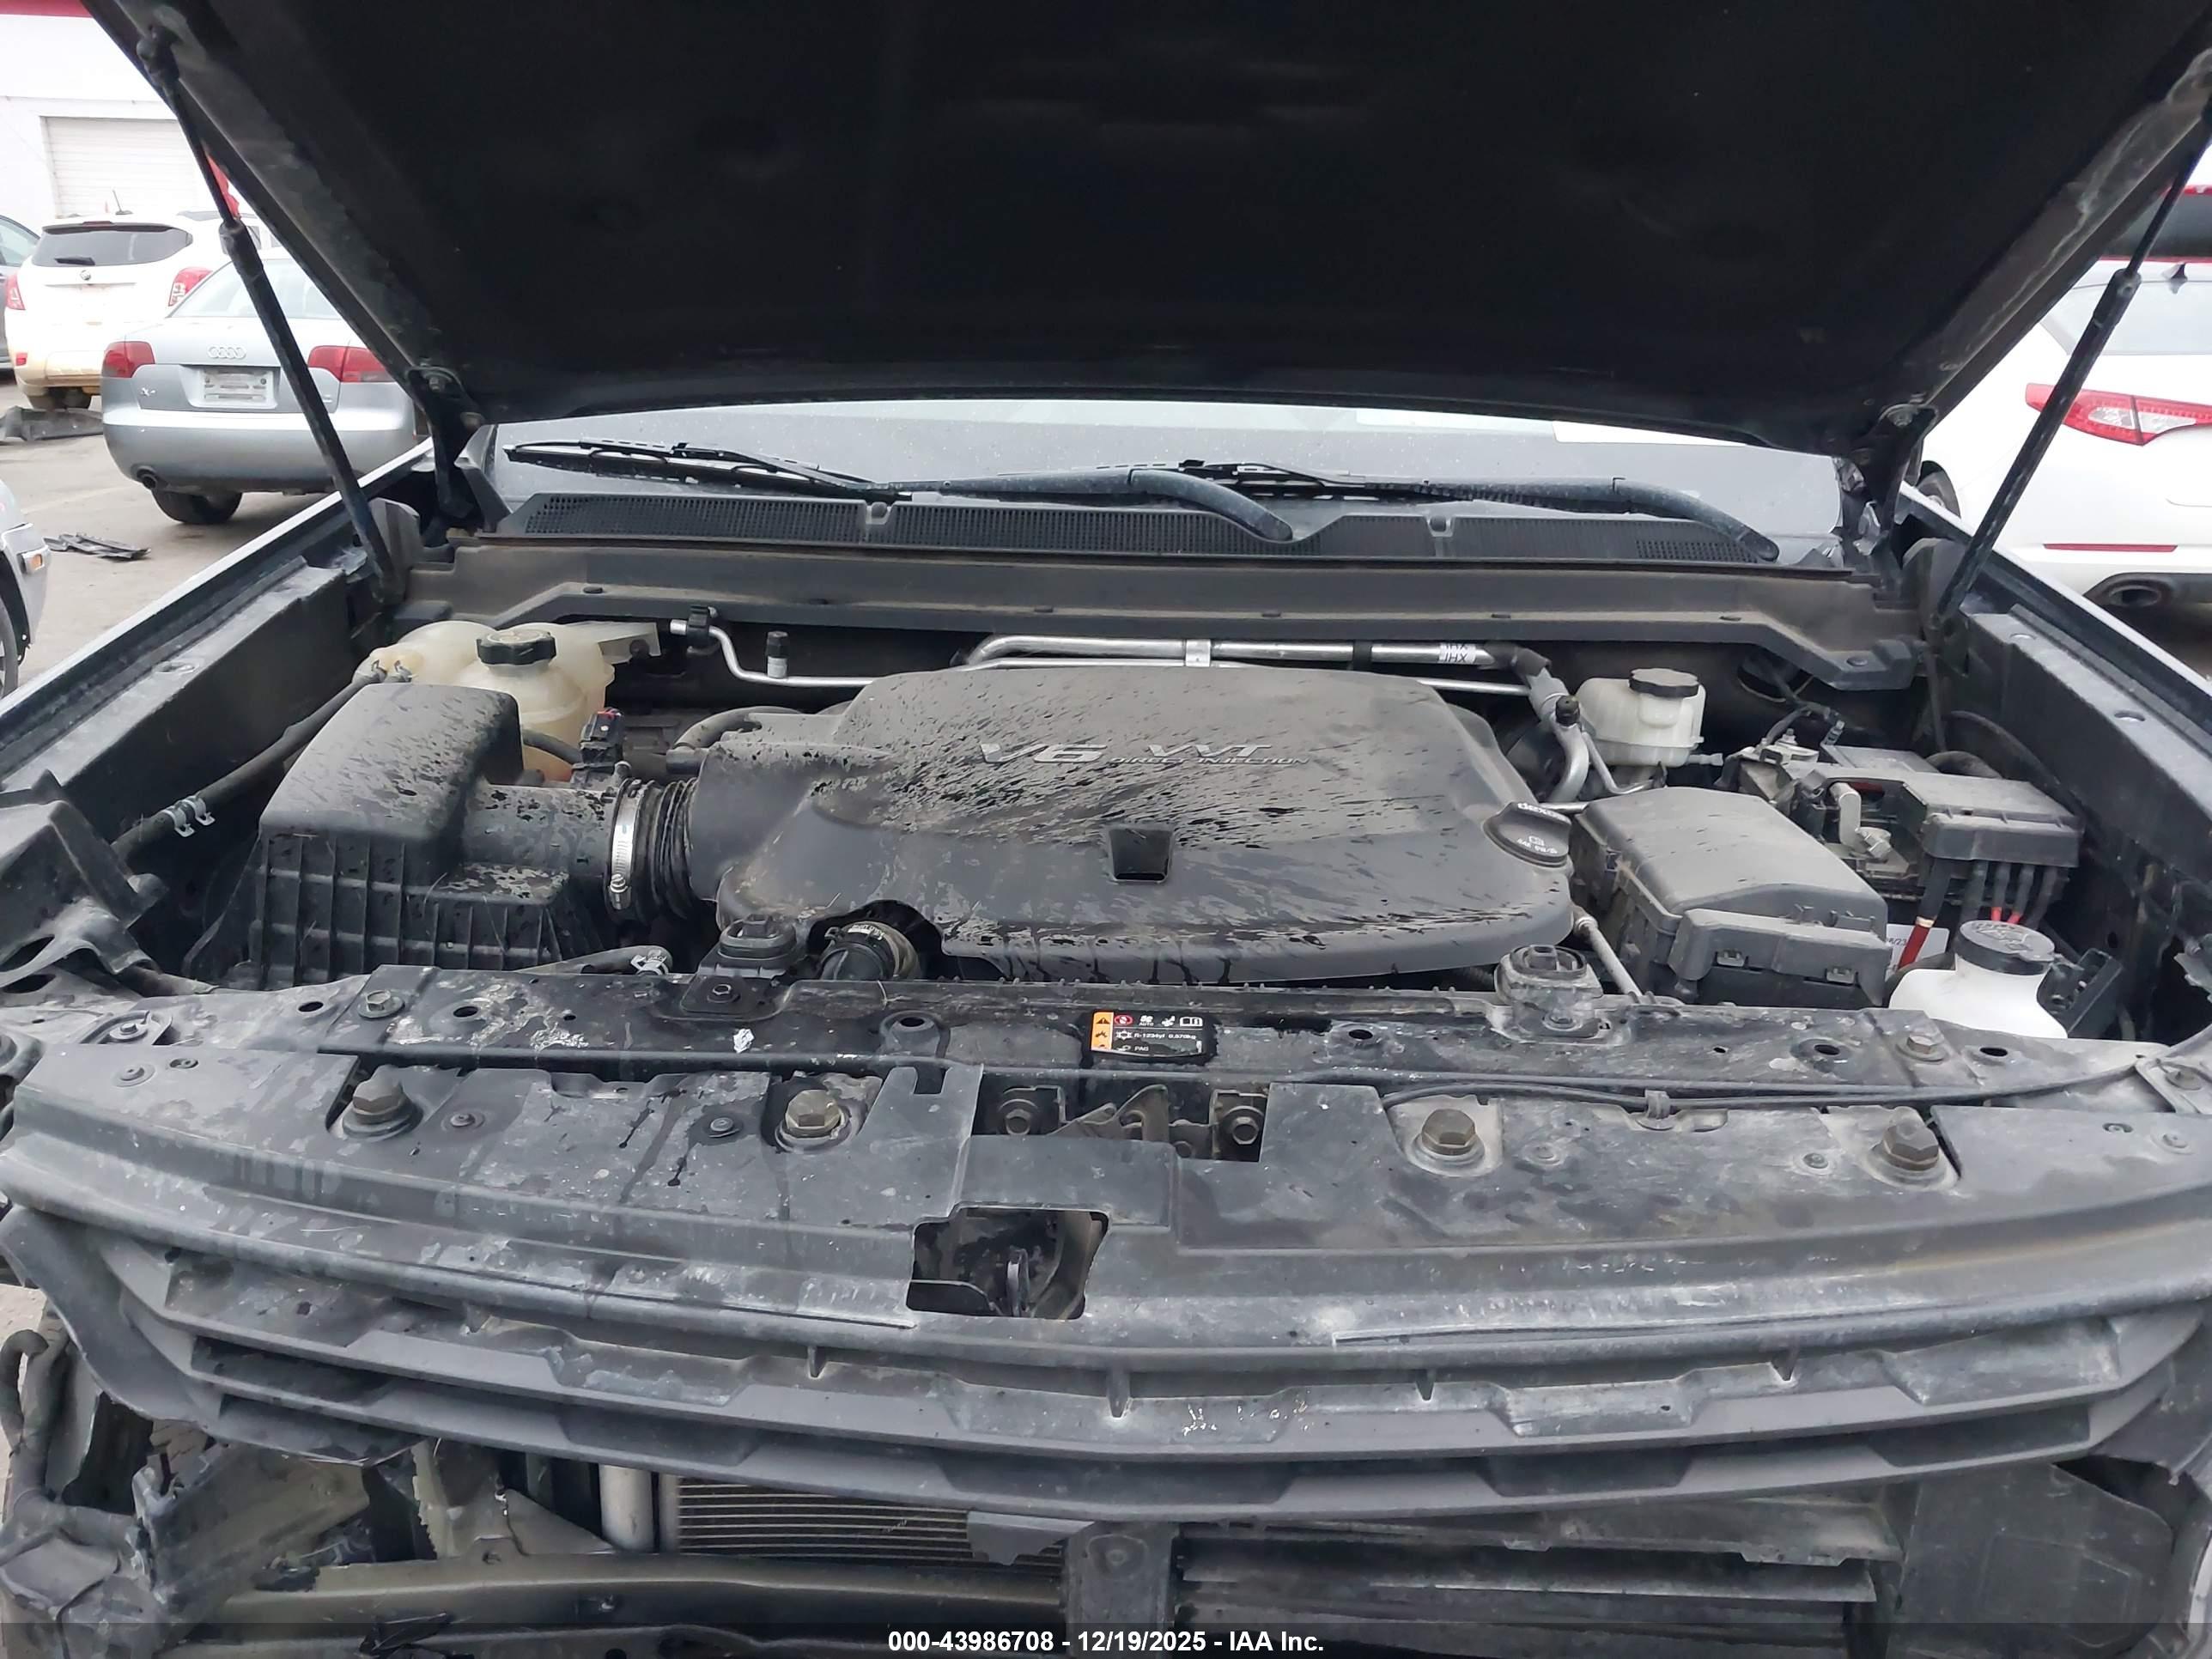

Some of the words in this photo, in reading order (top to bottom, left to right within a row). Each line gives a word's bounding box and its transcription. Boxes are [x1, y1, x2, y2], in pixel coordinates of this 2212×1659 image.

[981, 744, 1108, 763] V6
[1148, 744, 1272, 757] VVT
[1199, 757, 1310, 765] INJECTION
